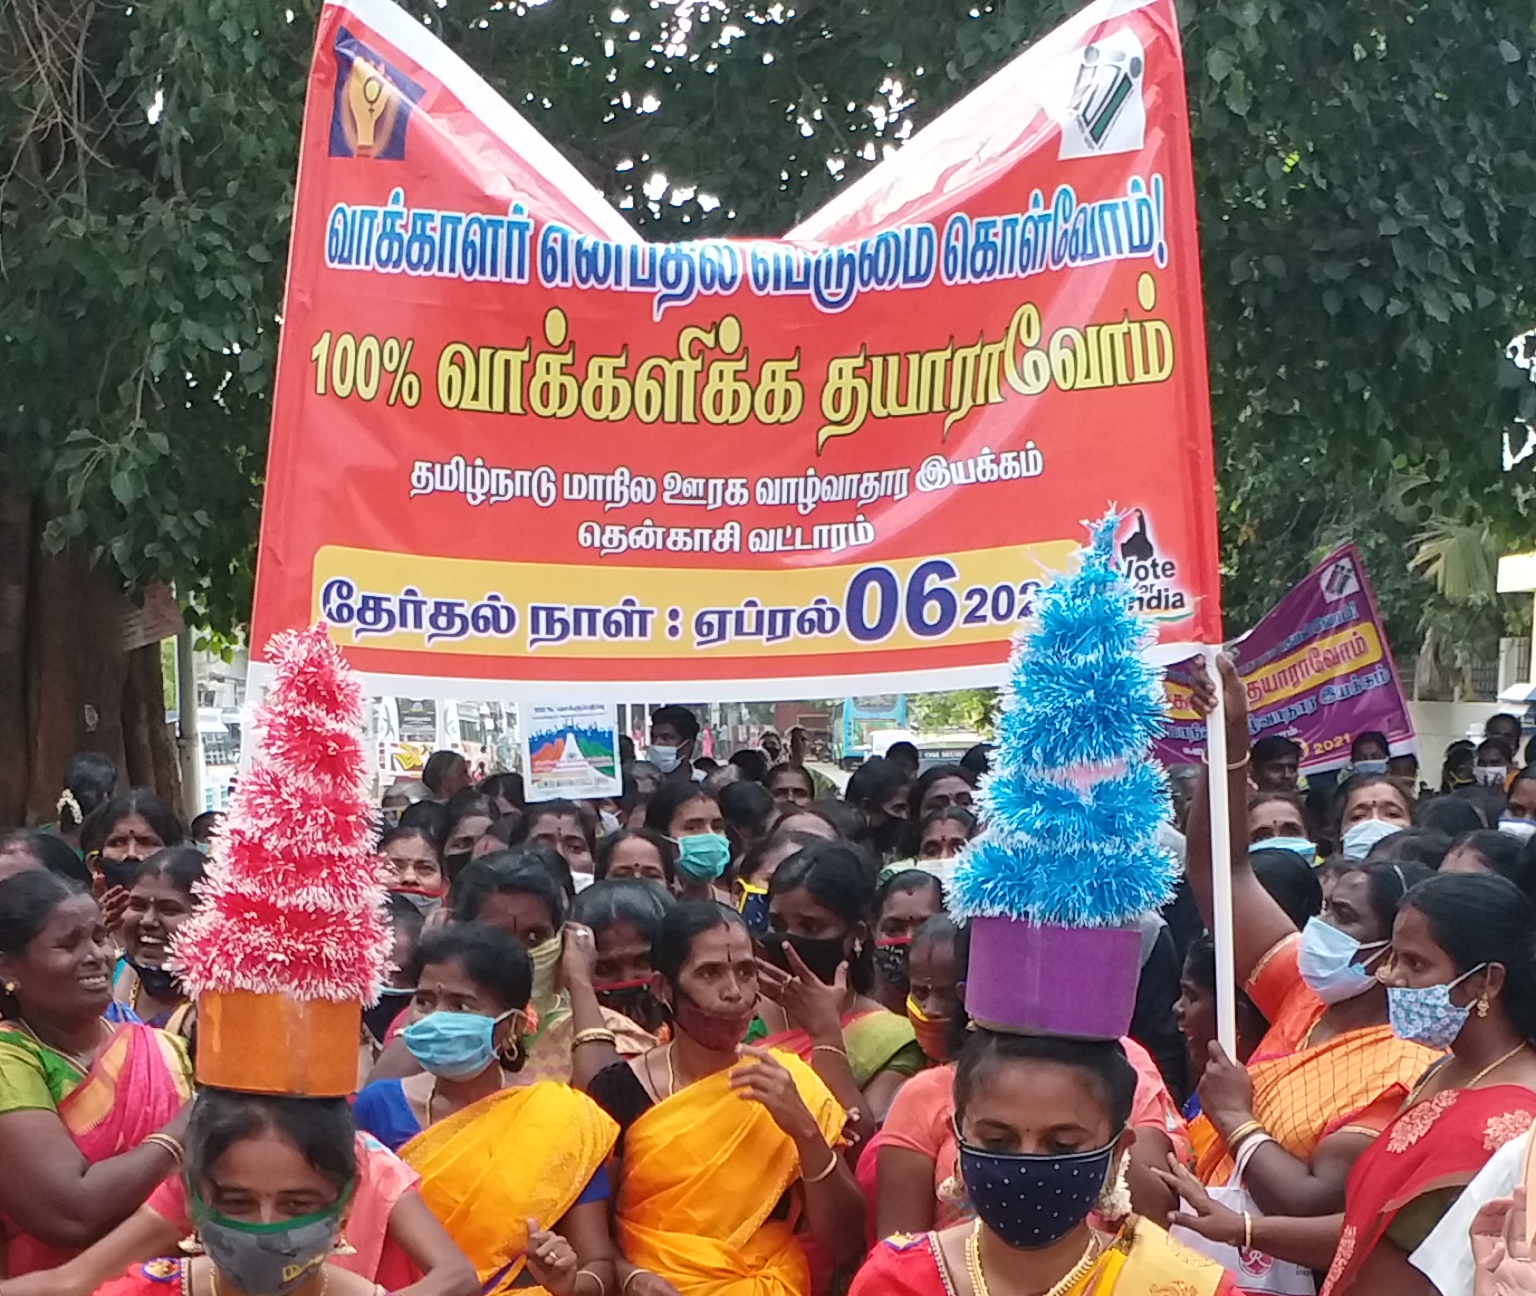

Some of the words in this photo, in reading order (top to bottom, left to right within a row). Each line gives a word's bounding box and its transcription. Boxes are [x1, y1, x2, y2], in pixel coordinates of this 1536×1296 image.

[327, 188, 534, 283] வாக்காளர்
[942, 174, 1168, 286] கொள்வோம்!
[311, 330, 421, 407] 100%
[437, 307, 804, 425] வாக்களிக்க
[816, 271, 1174, 457] தயாராவோம்
[410, 455, 557, 508] தமிழ்நாடு
[563, 465, 658, 512] மாநில
[662, 471, 750, 511] ஊரக
[754, 466, 911, 515] வாழ்வாதார
[914, 439, 1044, 493] இயக்கம்
[577, 517, 742, 557] தென்காசி
[747, 514, 876, 554] வட்டாரம்
[321, 576, 520, 644] தேர்தல்
[526, 596, 658, 652] நாள்
[693, 595, 842, 650] ஏப்ரல்
[844, 558, 960, 645] 06
[960, 580, 1043, 628] 202
[1128, 588, 1185, 612] ndia
[1313, 733, 1352, 755] 2021
